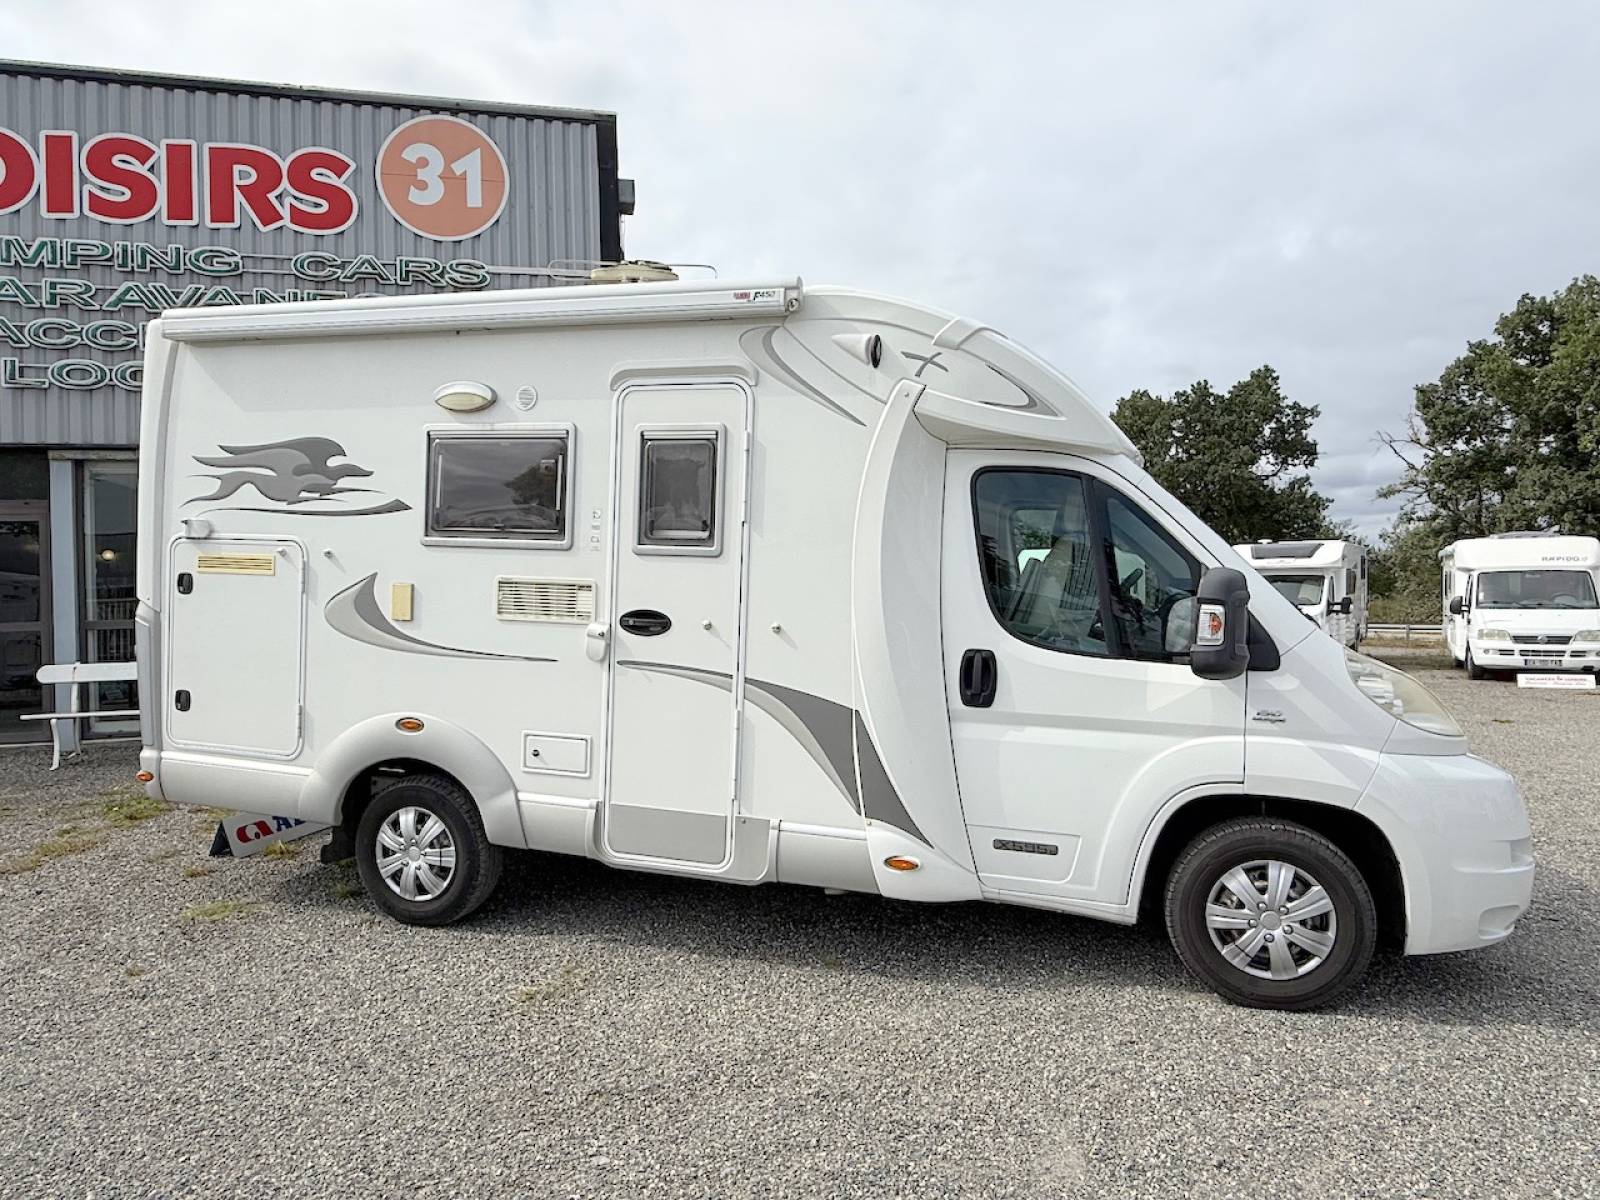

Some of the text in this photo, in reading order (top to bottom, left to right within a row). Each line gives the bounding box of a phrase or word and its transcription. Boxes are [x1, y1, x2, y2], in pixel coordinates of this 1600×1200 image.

[401, 144, 482, 208] 31
[0, 236, 490, 288] MPING CARS
